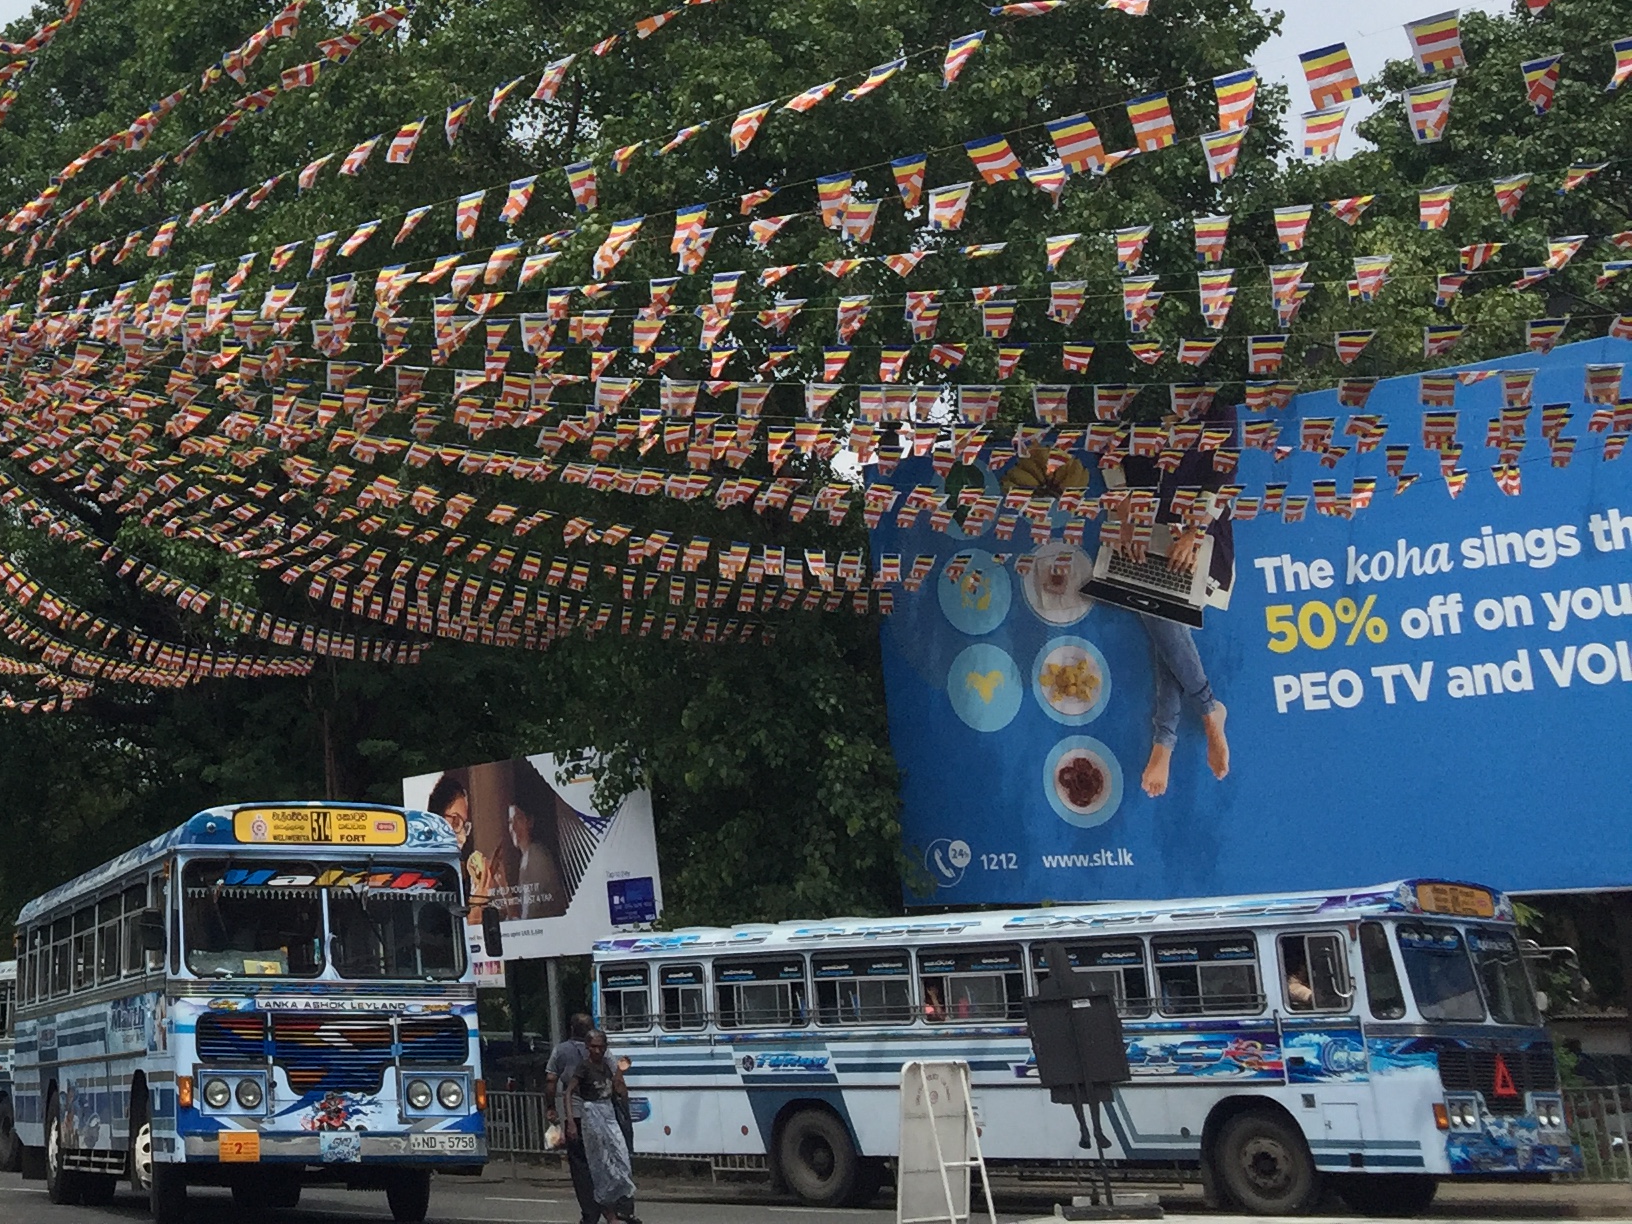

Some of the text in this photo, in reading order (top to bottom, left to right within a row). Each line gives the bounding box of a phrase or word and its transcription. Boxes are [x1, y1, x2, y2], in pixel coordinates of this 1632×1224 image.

[1254, 554, 1335, 594] The
[1344, 538, 1454, 585] koha
[1461, 525, 1582, 569] sings
[1265, 594, 1389, 654] 50%
[1401, 593, 1464, 639] off
[1474, 595, 1535, 632] on
[1273, 669, 1364, 714] PEO
[1371, 661, 1434, 705] TV
[1447, 649, 1535, 699] and
[311, 811, 333, 842] 514
[339, 834, 366, 842] FORT
[980, 853, 1018, 870] 1212
[1042, 848, 1135, 869] www.slt.lk
[257, 999, 407, 1011] LANKA ASHOK LEYLAND
[234, 1142, 243, 1155] 2
